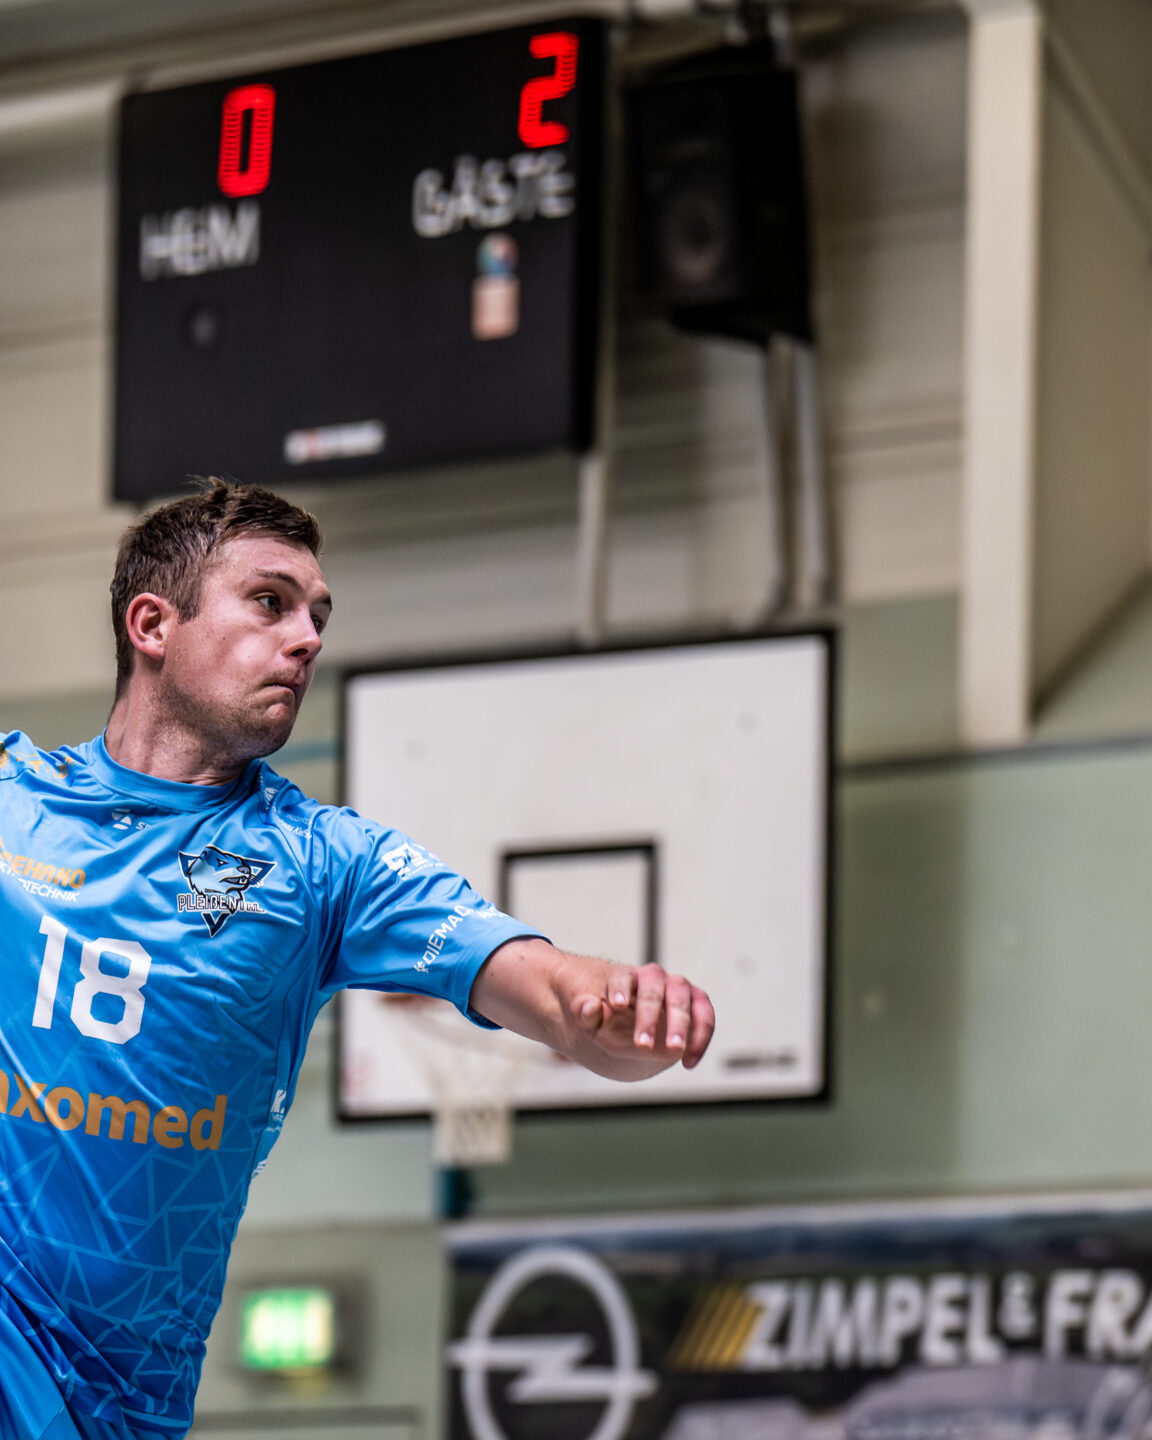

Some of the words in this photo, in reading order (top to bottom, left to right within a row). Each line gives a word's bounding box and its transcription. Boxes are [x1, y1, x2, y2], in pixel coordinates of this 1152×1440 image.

[217, 83, 276, 198] 0
[519, 31, 579, 148] 2
[32, 915, 152, 1045] 18
[745, 1272, 1001, 1368] ZIMPEL
[999, 1270, 1038, 1340] &
